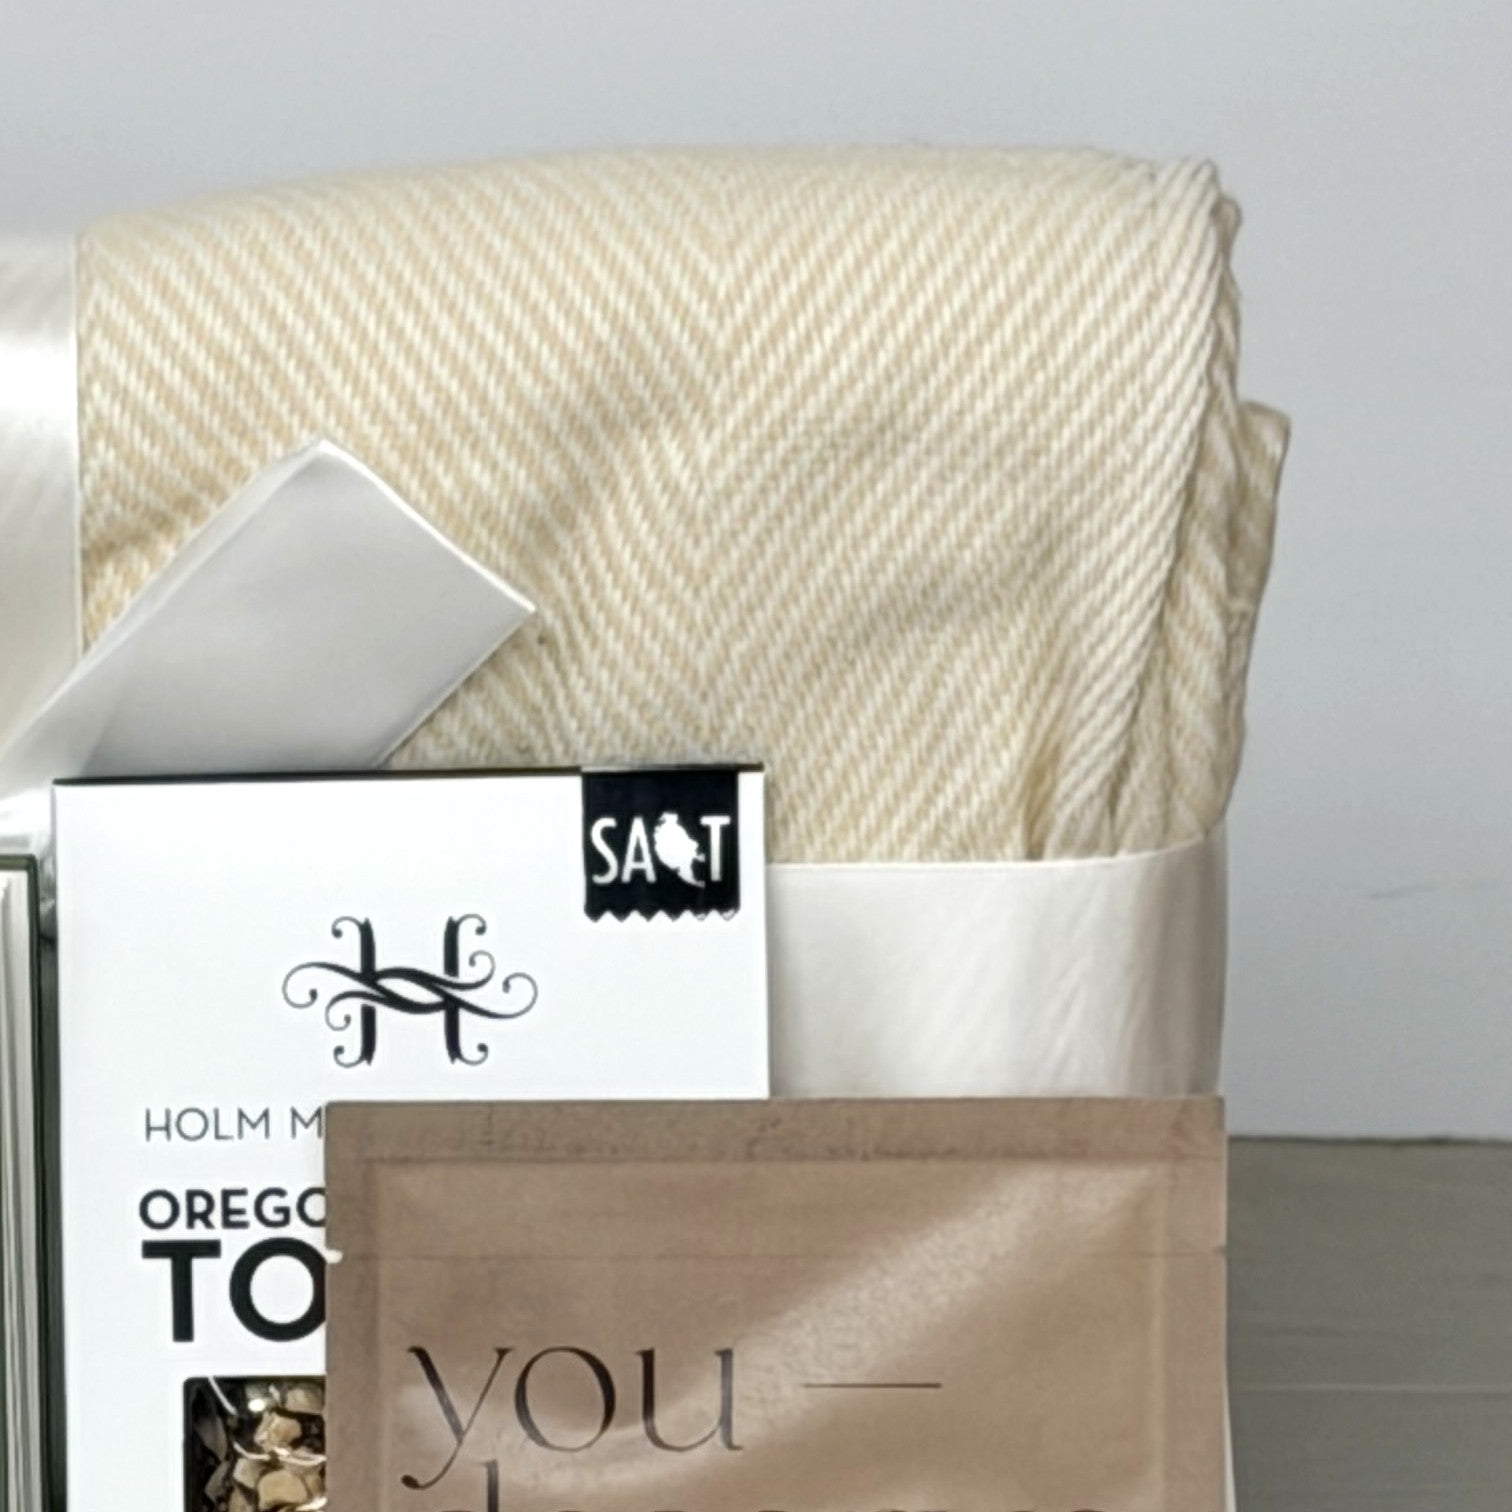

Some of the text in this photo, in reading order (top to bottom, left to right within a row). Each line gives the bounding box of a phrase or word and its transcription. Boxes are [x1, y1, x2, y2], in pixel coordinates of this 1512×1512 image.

[590, 811, 732, 889] SAT
[144, 1105, 324, 1142] HOLM M
[139, 1186, 325, 1231] OREGO
[141, 1237, 326, 1343] TO
[400, 1345, 744, 1491] you
